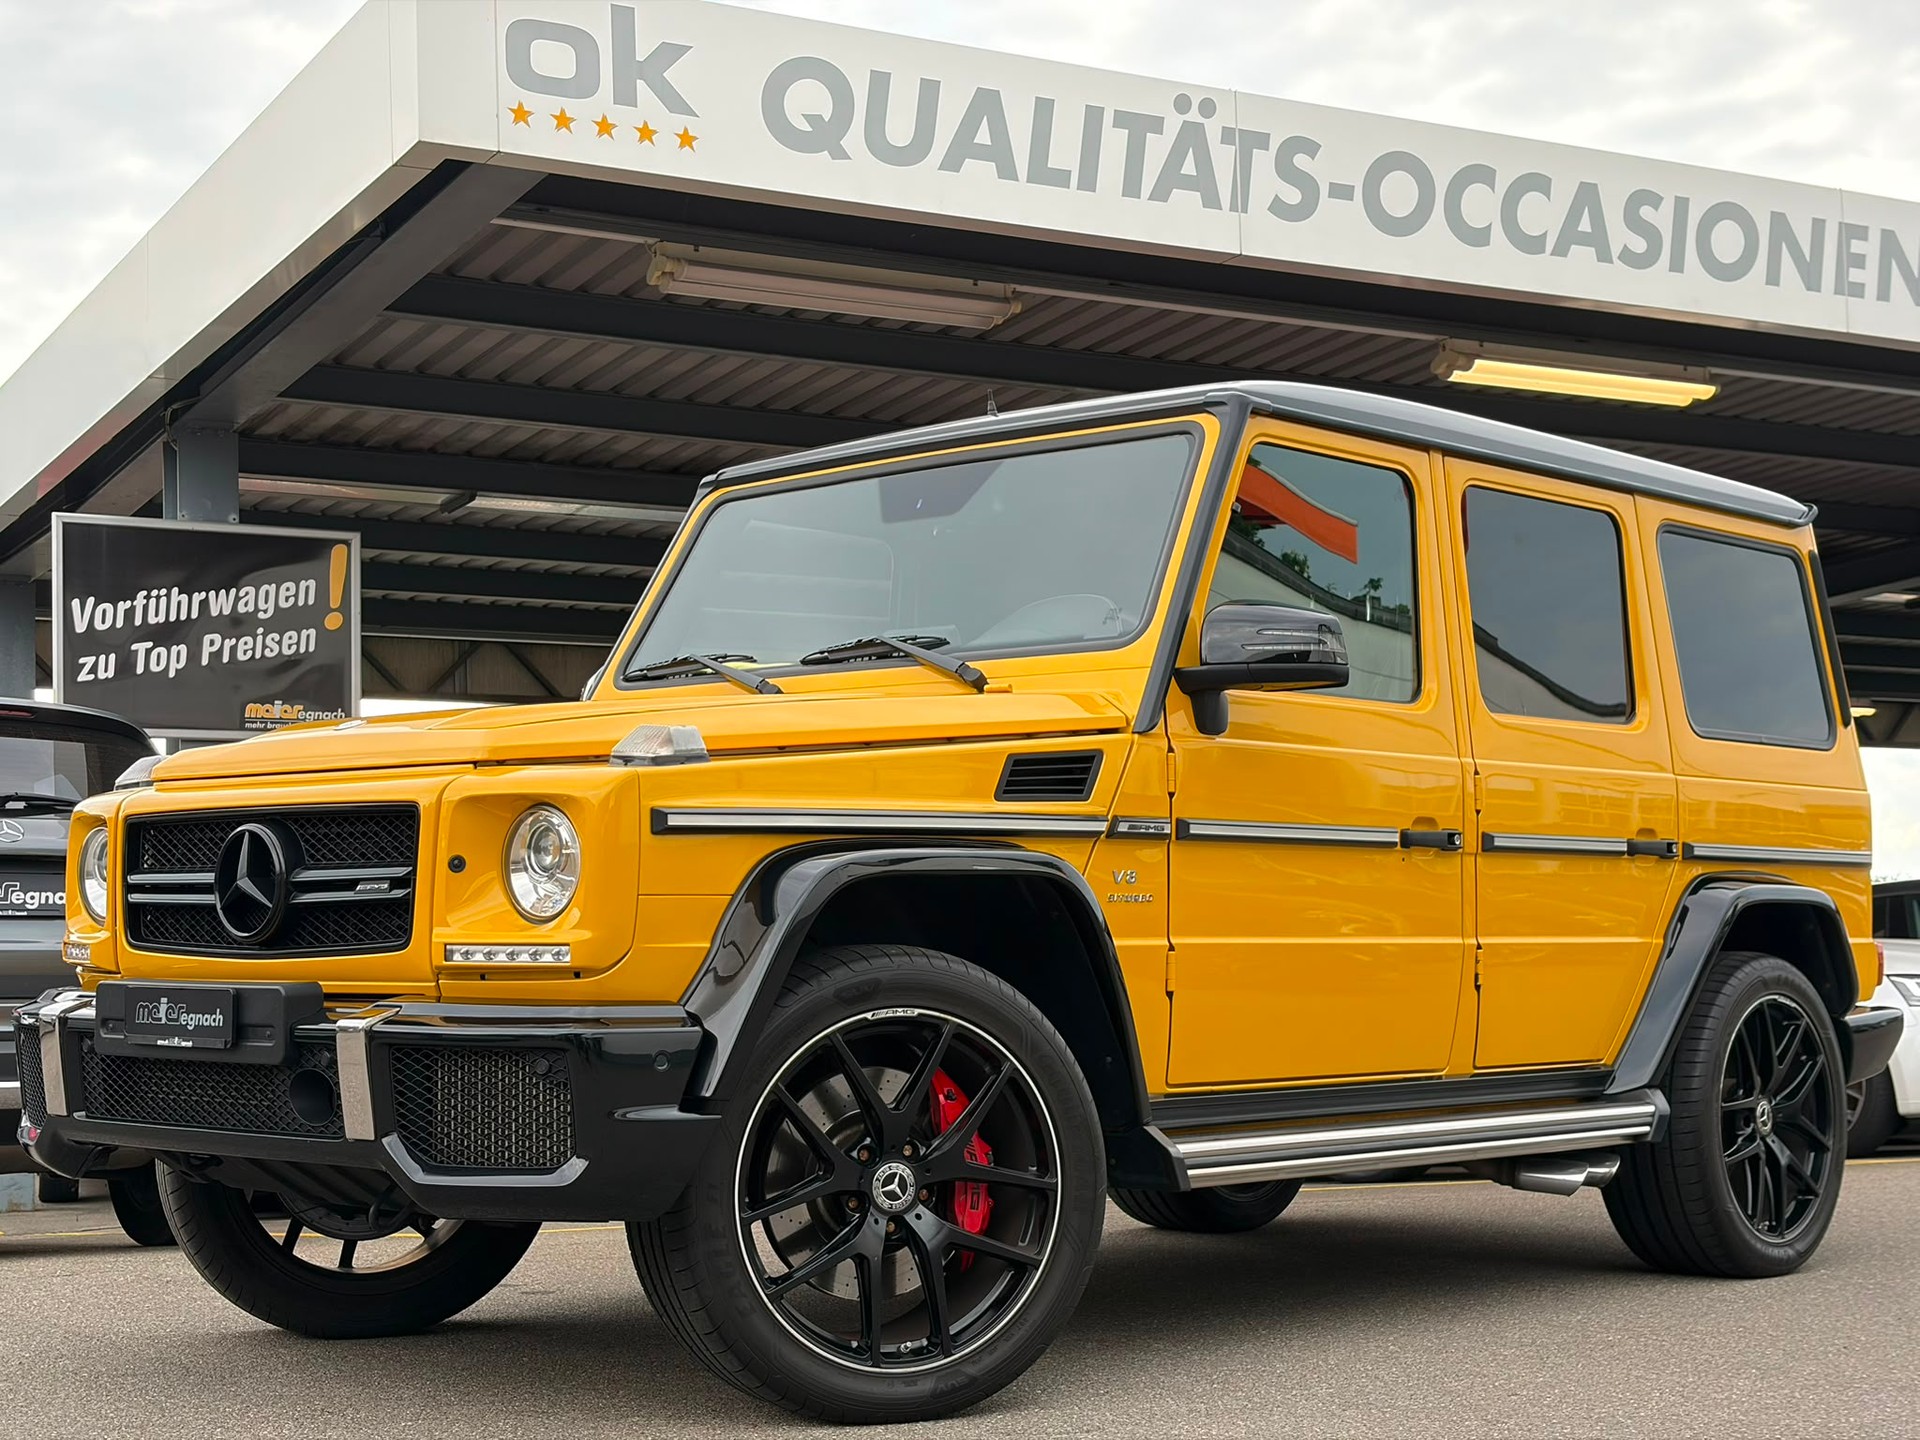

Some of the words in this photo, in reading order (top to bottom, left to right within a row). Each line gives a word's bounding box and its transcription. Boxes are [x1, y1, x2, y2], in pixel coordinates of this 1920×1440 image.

[505, 3, 700, 119] ok
[71, 578, 316, 634] Vorführwagen
[76, 651, 116, 682] zu
[131, 641, 188, 678] Top
[201, 627, 317, 667] Preisen
[1113, 869, 1137, 885] V8
